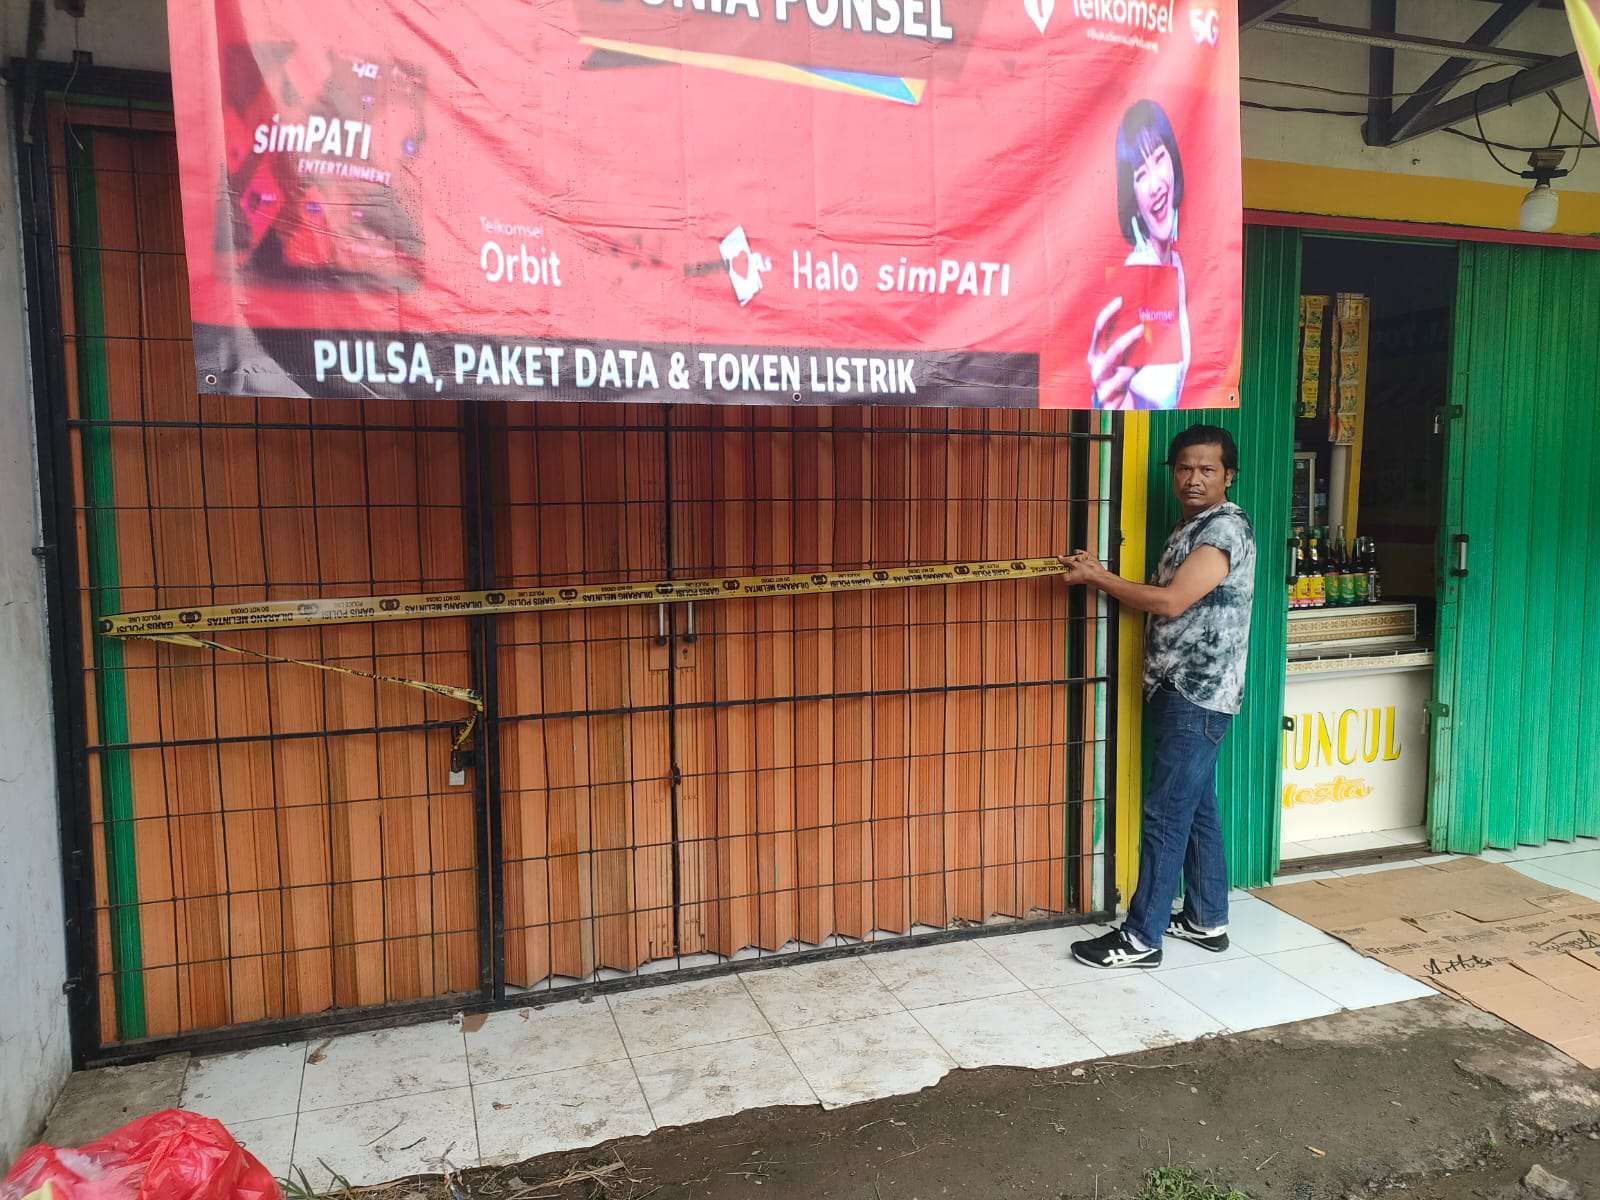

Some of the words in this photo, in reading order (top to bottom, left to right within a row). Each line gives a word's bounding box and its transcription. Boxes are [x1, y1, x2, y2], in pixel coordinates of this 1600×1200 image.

[1189, 8, 1220, 47] 5G
[253, 115, 371, 161] simPATI
[298, 158, 392, 186] ENTERTAINMENT
[479, 216, 544, 238] Telkomsel
[480, 240, 562, 288] Orbit
[792, 248, 859, 294] Halo
[876, 255, 1011, 297] simPATI
[313, 339, 444, 392] PULSA,
[453, 342, 563, 388] PAKET
[574, 348, 659, 390] DATA
[668, 351, 690, 390] &
[699, 352, 801, 393] TOKEN
[810, 355, 917, 395] LISTRIK
